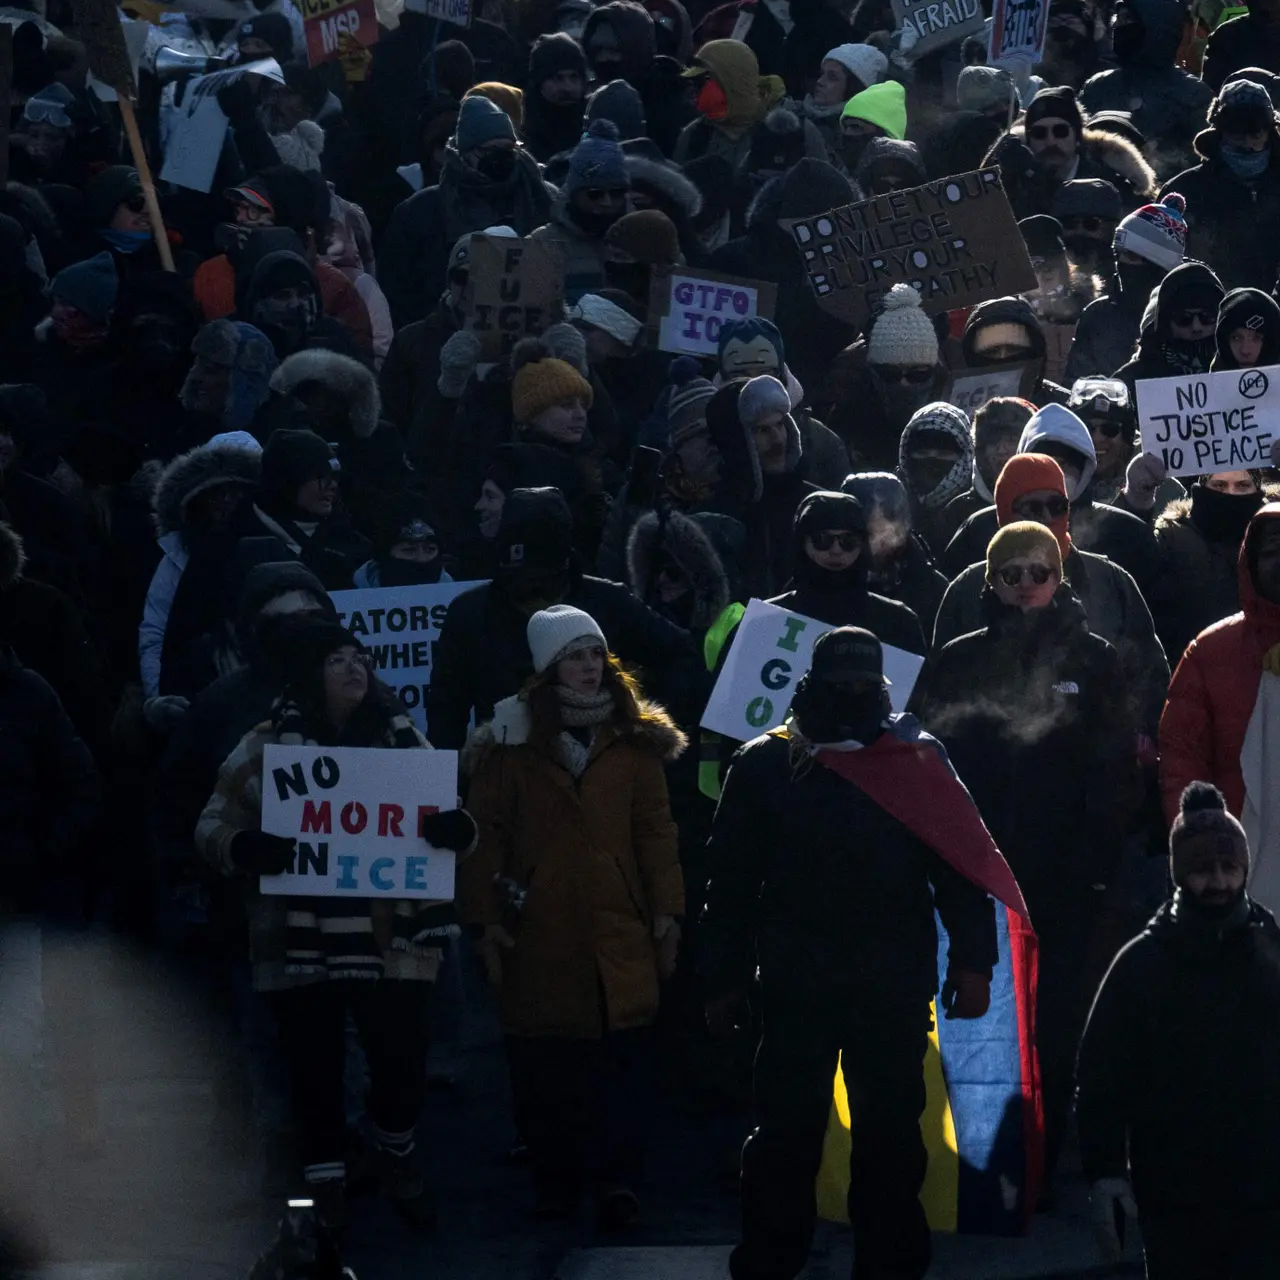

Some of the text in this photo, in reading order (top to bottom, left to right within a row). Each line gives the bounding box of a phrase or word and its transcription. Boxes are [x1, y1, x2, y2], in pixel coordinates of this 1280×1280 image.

[674, 281, 749, 314] GTFO
[1176, 382, 1206, 409] NO
[1149, 405, 1257, 441] JUSTICE
[1194, 434, 1272, 468] PEACE
[272, 755, 340, 801] NO
[336, 855, 429, 890] ICE
